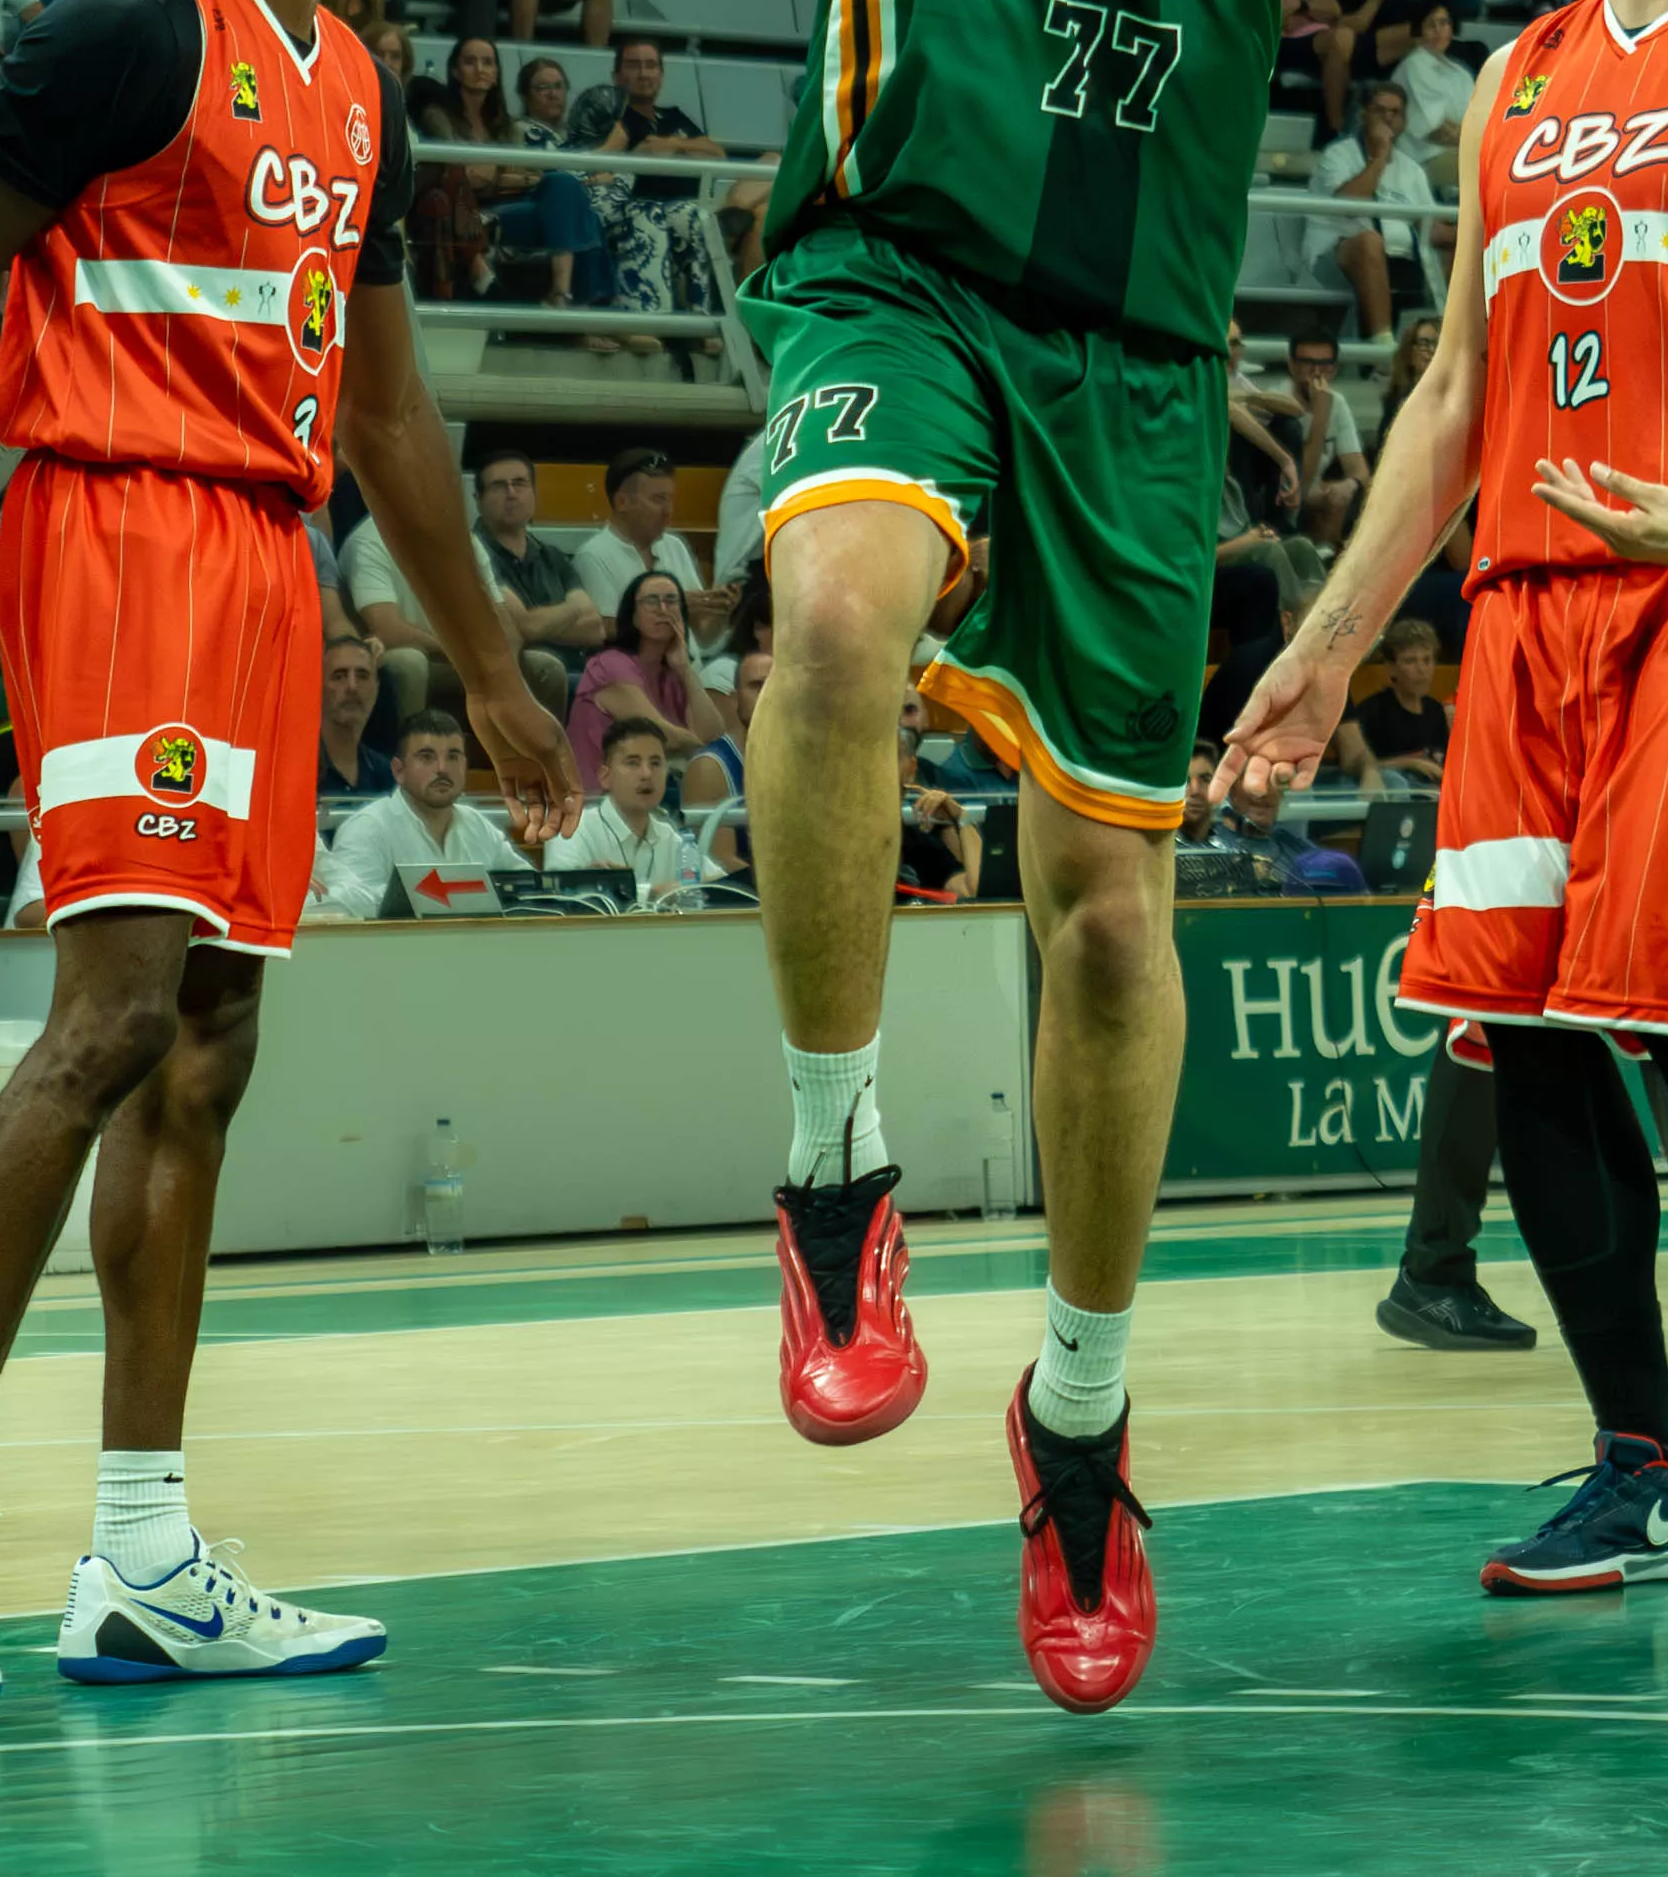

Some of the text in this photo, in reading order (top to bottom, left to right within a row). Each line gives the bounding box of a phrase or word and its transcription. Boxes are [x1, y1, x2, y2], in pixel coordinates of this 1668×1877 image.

[245, 144, 361, 253] CBZ
[1547, 329, 1610, 411] 12
[764, 382, 880, 476] 77
[133, 812, 198, 842] CBZ
